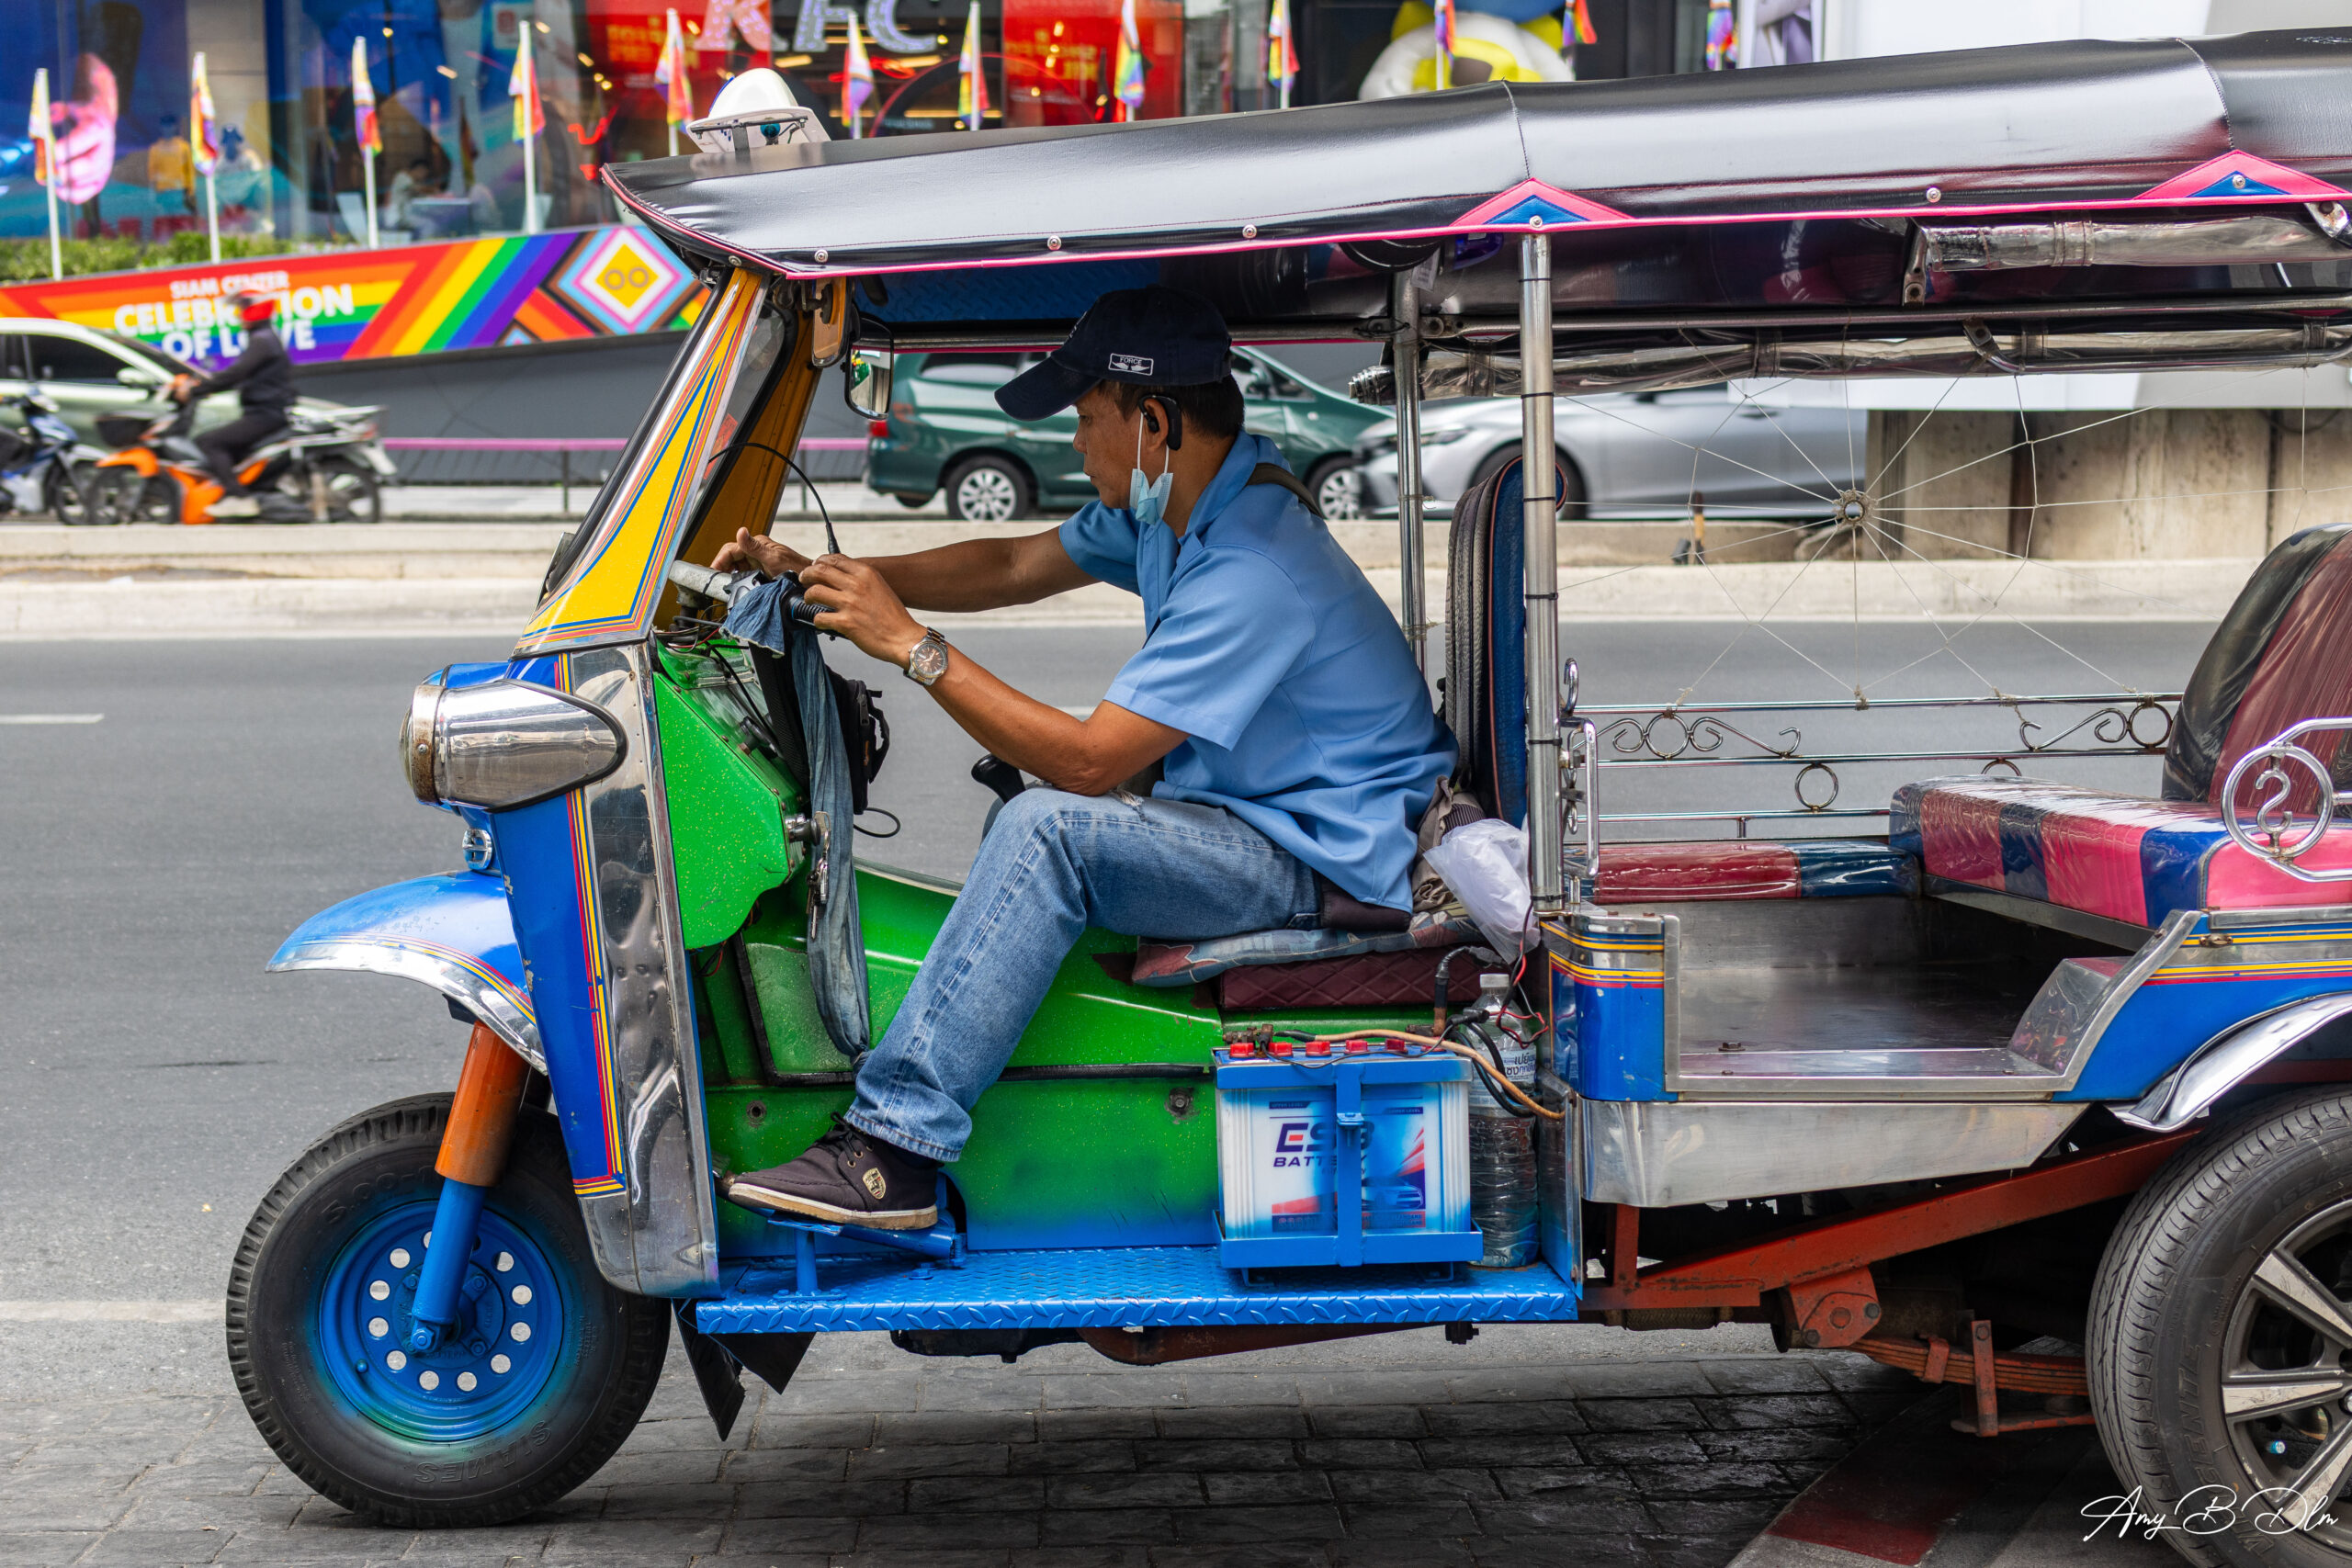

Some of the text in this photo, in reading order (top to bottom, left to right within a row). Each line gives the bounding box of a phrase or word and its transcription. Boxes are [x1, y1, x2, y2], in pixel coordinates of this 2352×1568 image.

[170, 277, 219, 299] SIAM
[114, 284, 355, 338] CELEBRION
[161, 329, 212, 361] OF
[1119, 356, 1143, 366] FORCE
[1273, 1154, 1367, 1168] BATTE
